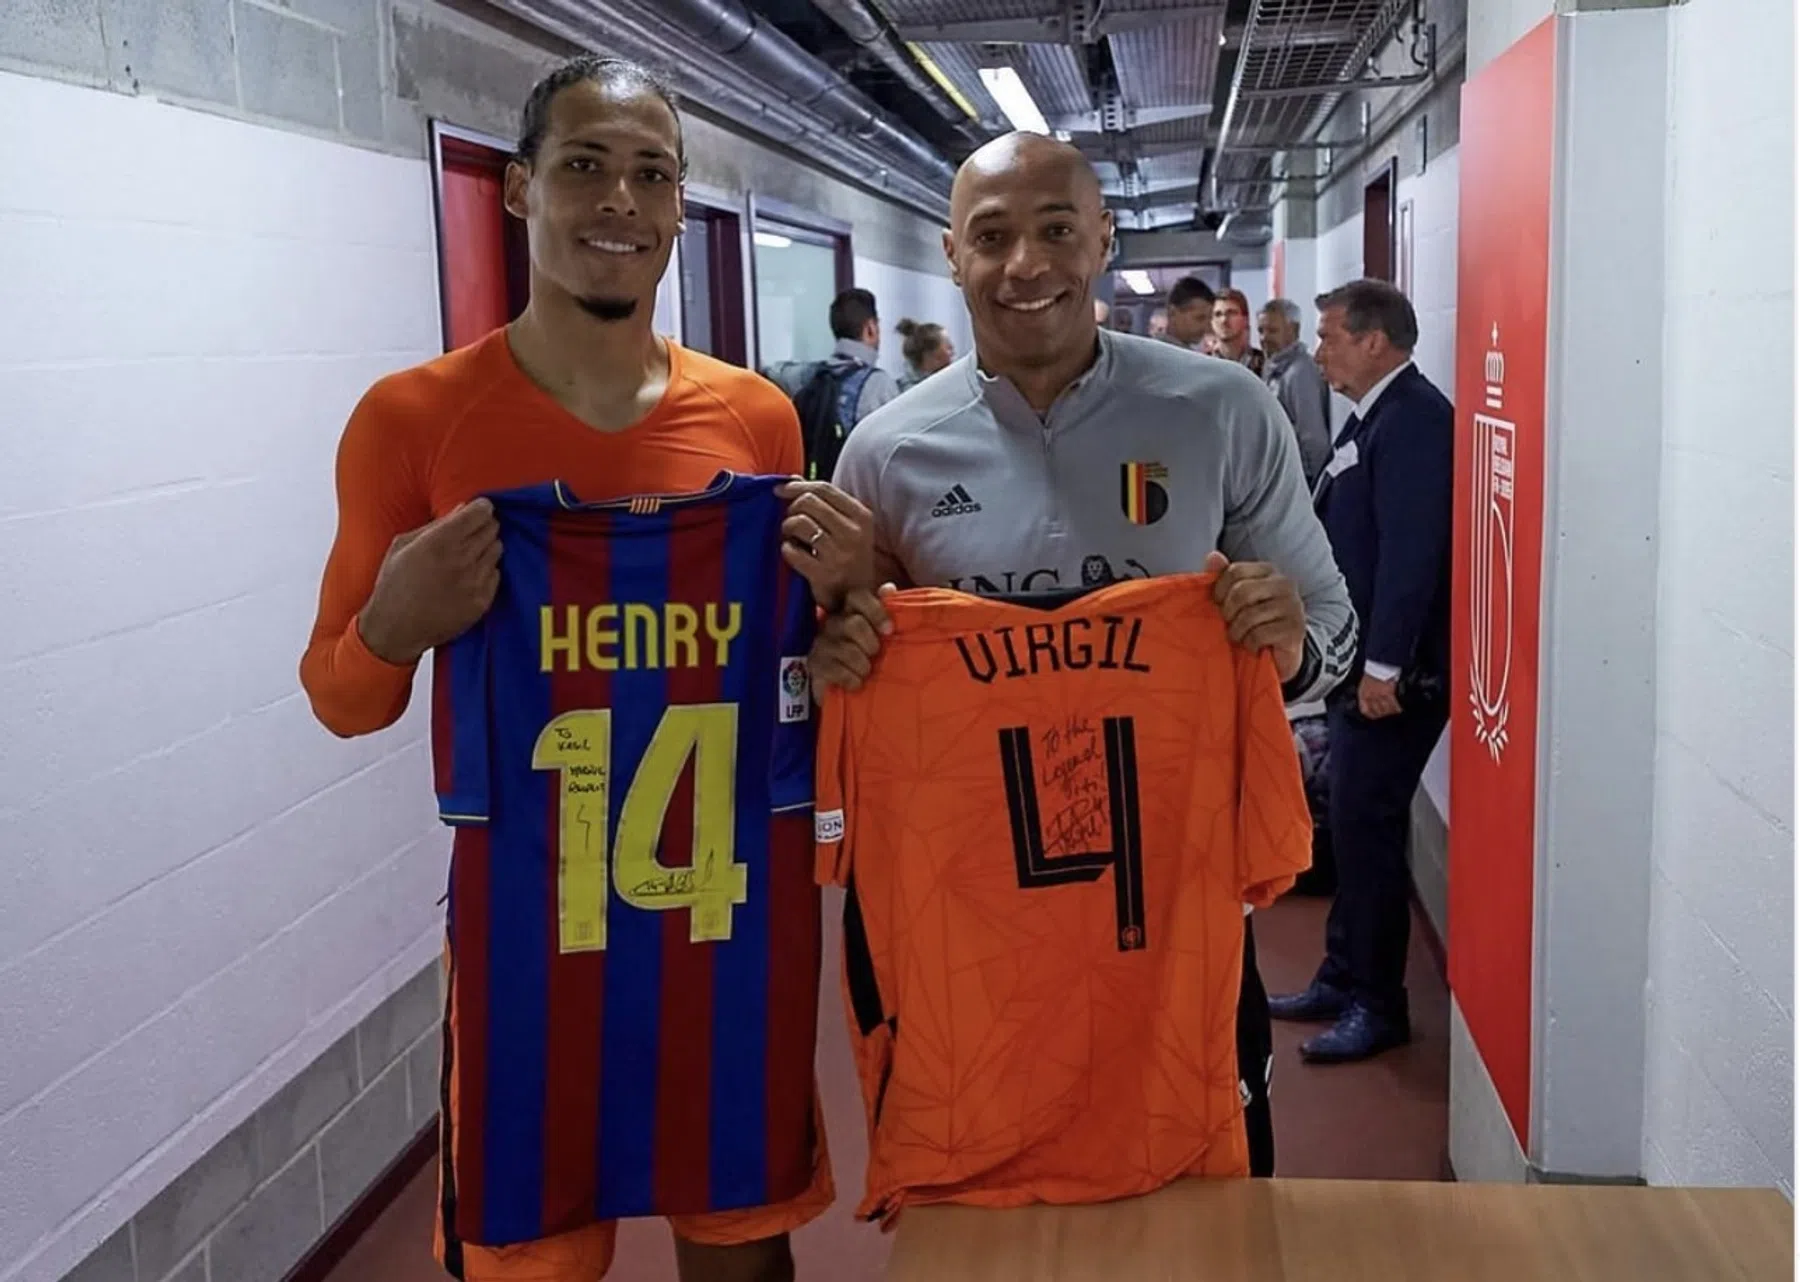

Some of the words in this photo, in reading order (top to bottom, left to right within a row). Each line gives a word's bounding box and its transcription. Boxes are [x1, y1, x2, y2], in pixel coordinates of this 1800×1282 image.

[931, 501, 982, 518] adidas
[540, 602, 742, 672] HENRY
[955, 617, 1151, 684] VIRGIL
[532, 702, 747, 954] 14
[998, 716, 1146, 952] 4
